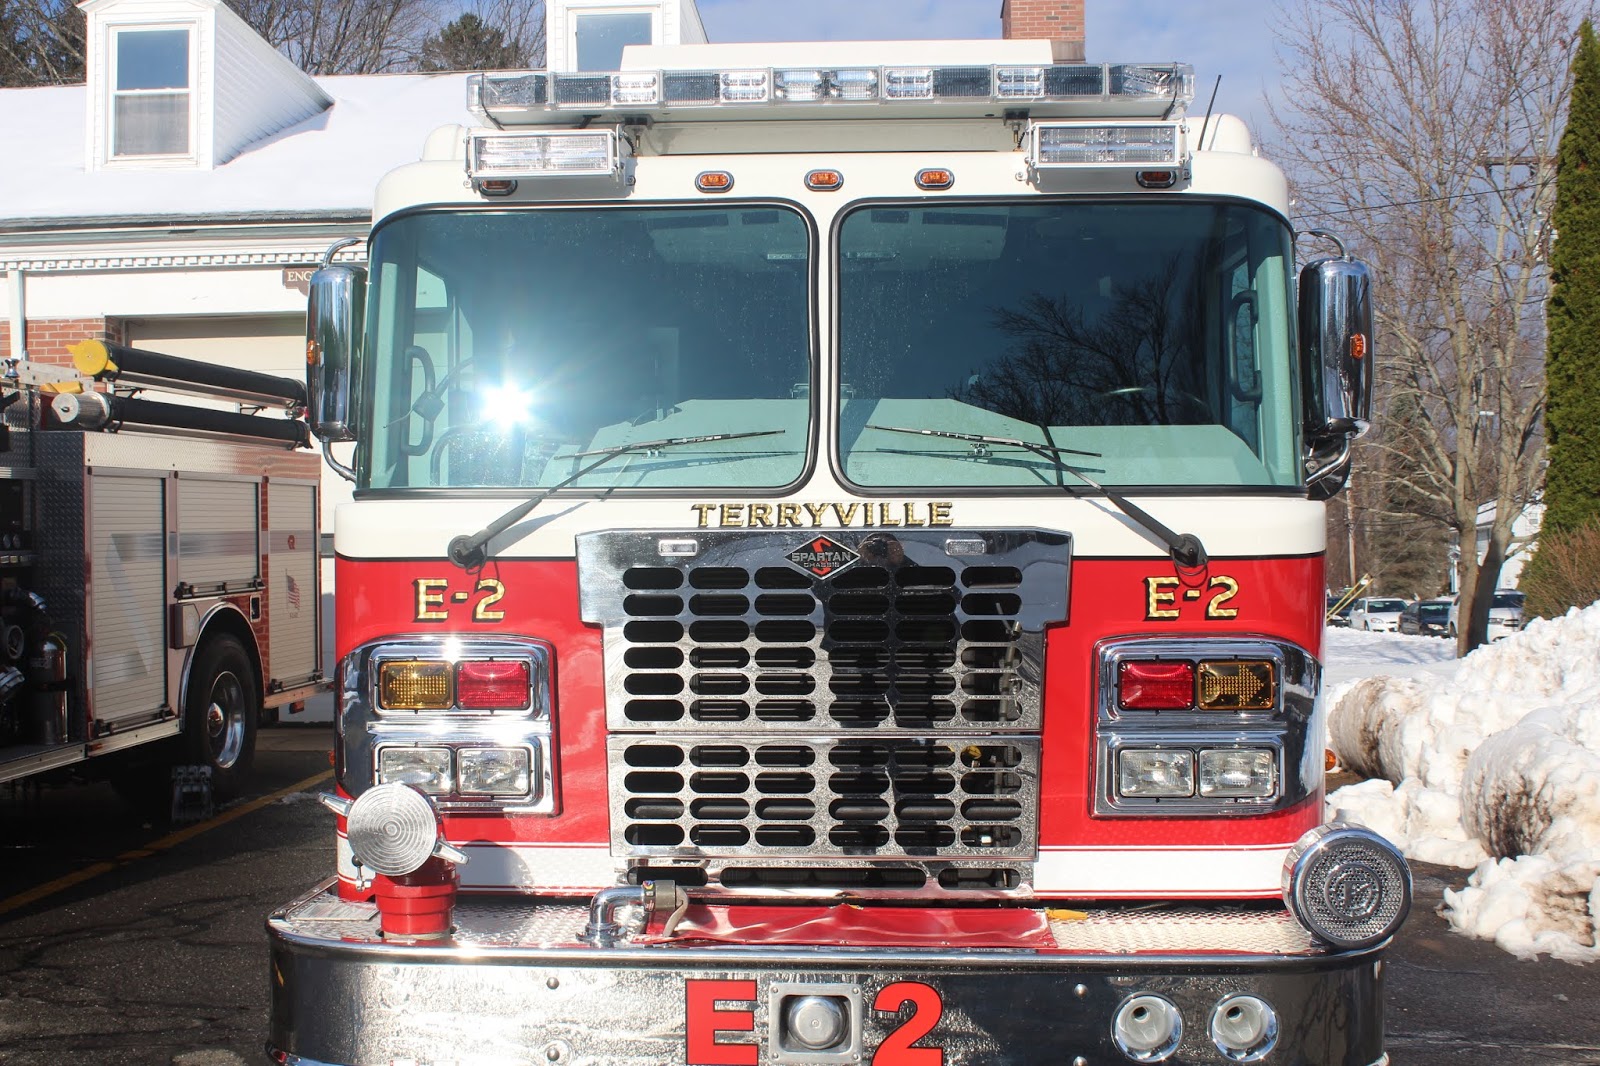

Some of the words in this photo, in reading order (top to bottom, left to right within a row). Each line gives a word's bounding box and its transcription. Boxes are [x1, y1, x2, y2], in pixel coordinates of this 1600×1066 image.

[287, 270, 315, 282] ENG
[691, 501, 954, 528] TERRYVILLE
[791, 551, 851, 562] SPARTAN
[412, 578, 506, 623] E-2
[1142, 575, 1239, 621] E-2
[685, 979, 759, 1065] E
[870, 980, 944, 1066] 2
